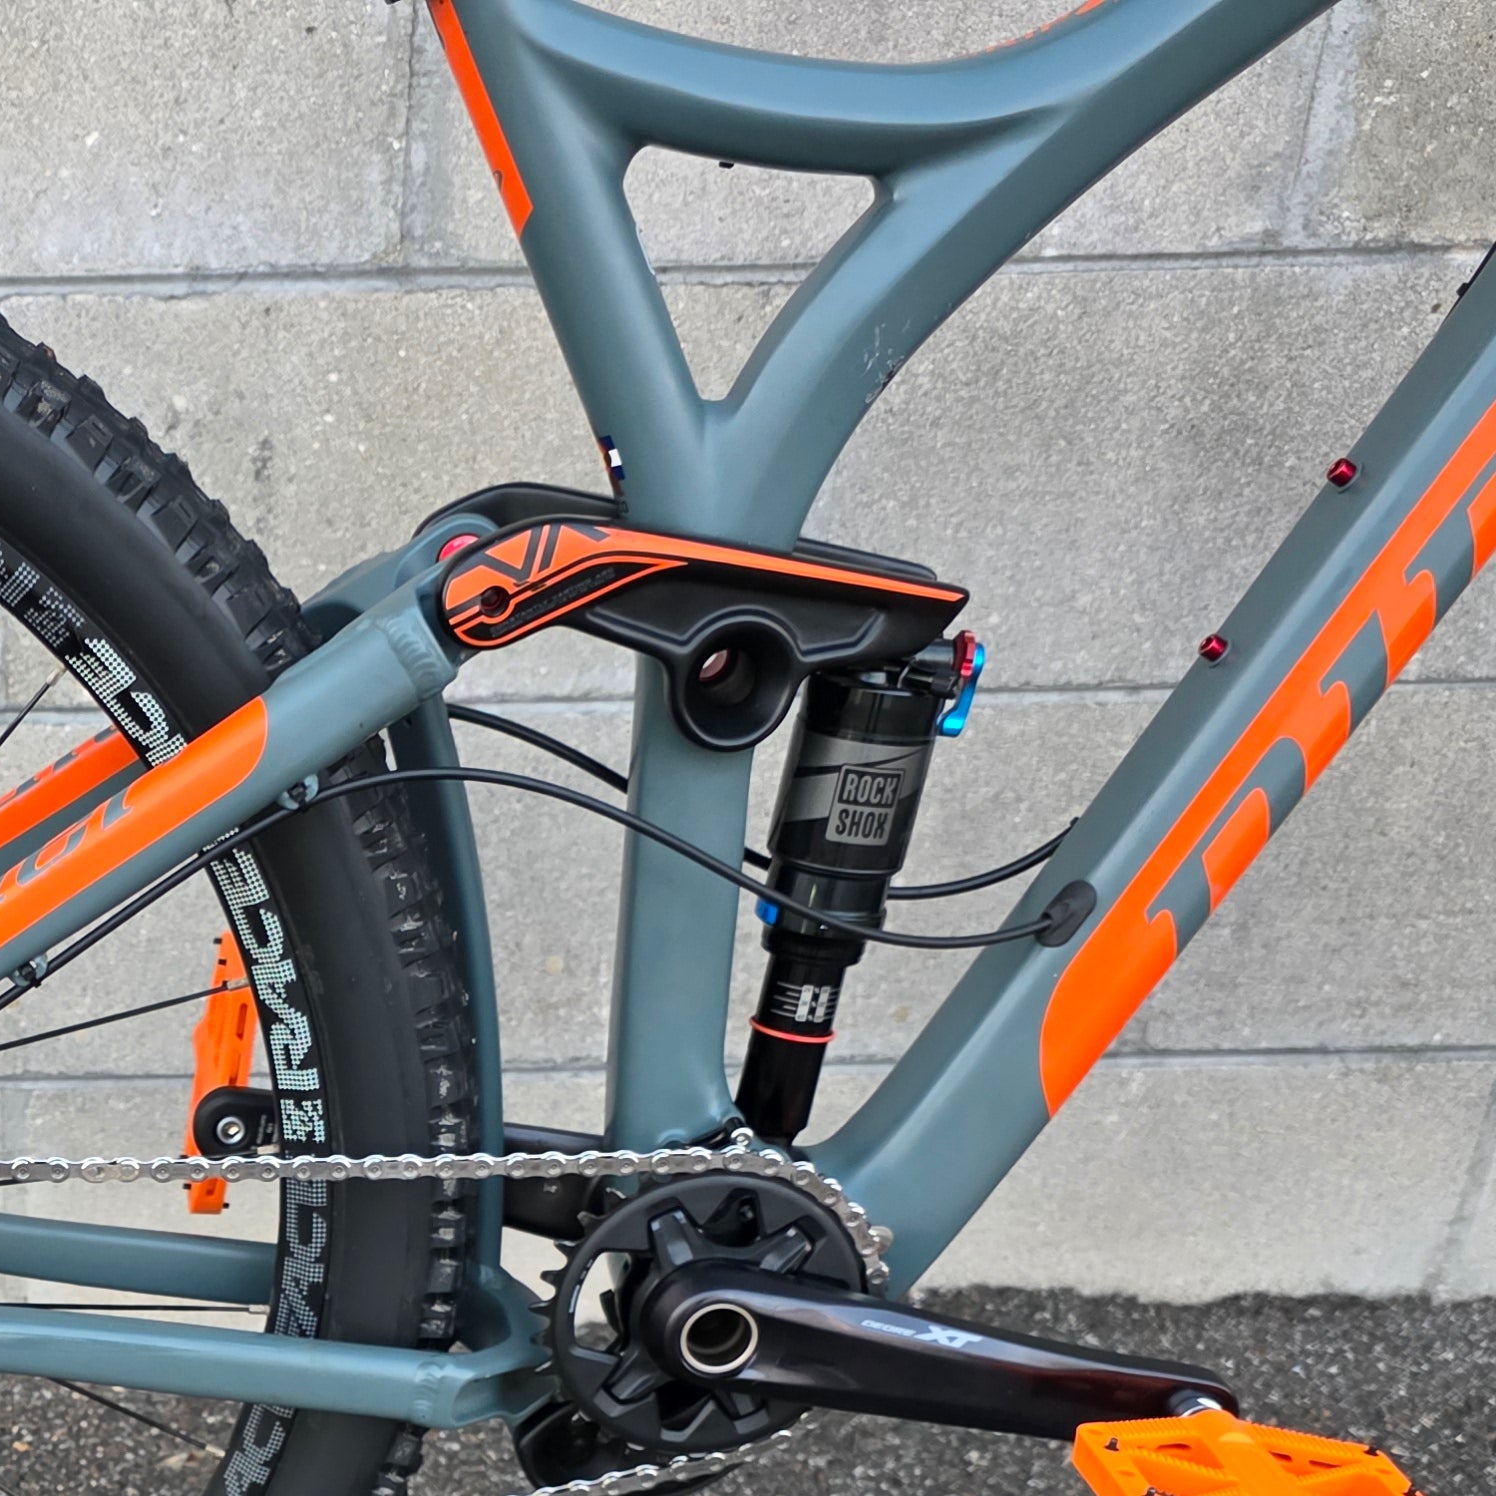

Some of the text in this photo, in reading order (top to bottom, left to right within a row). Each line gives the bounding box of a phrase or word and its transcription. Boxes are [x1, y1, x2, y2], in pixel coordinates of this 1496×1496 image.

[843, 773, 898, 805] ROCK
[835, 809, 888, 839] SHOX
[913, 1325, 983, 1348] XT
